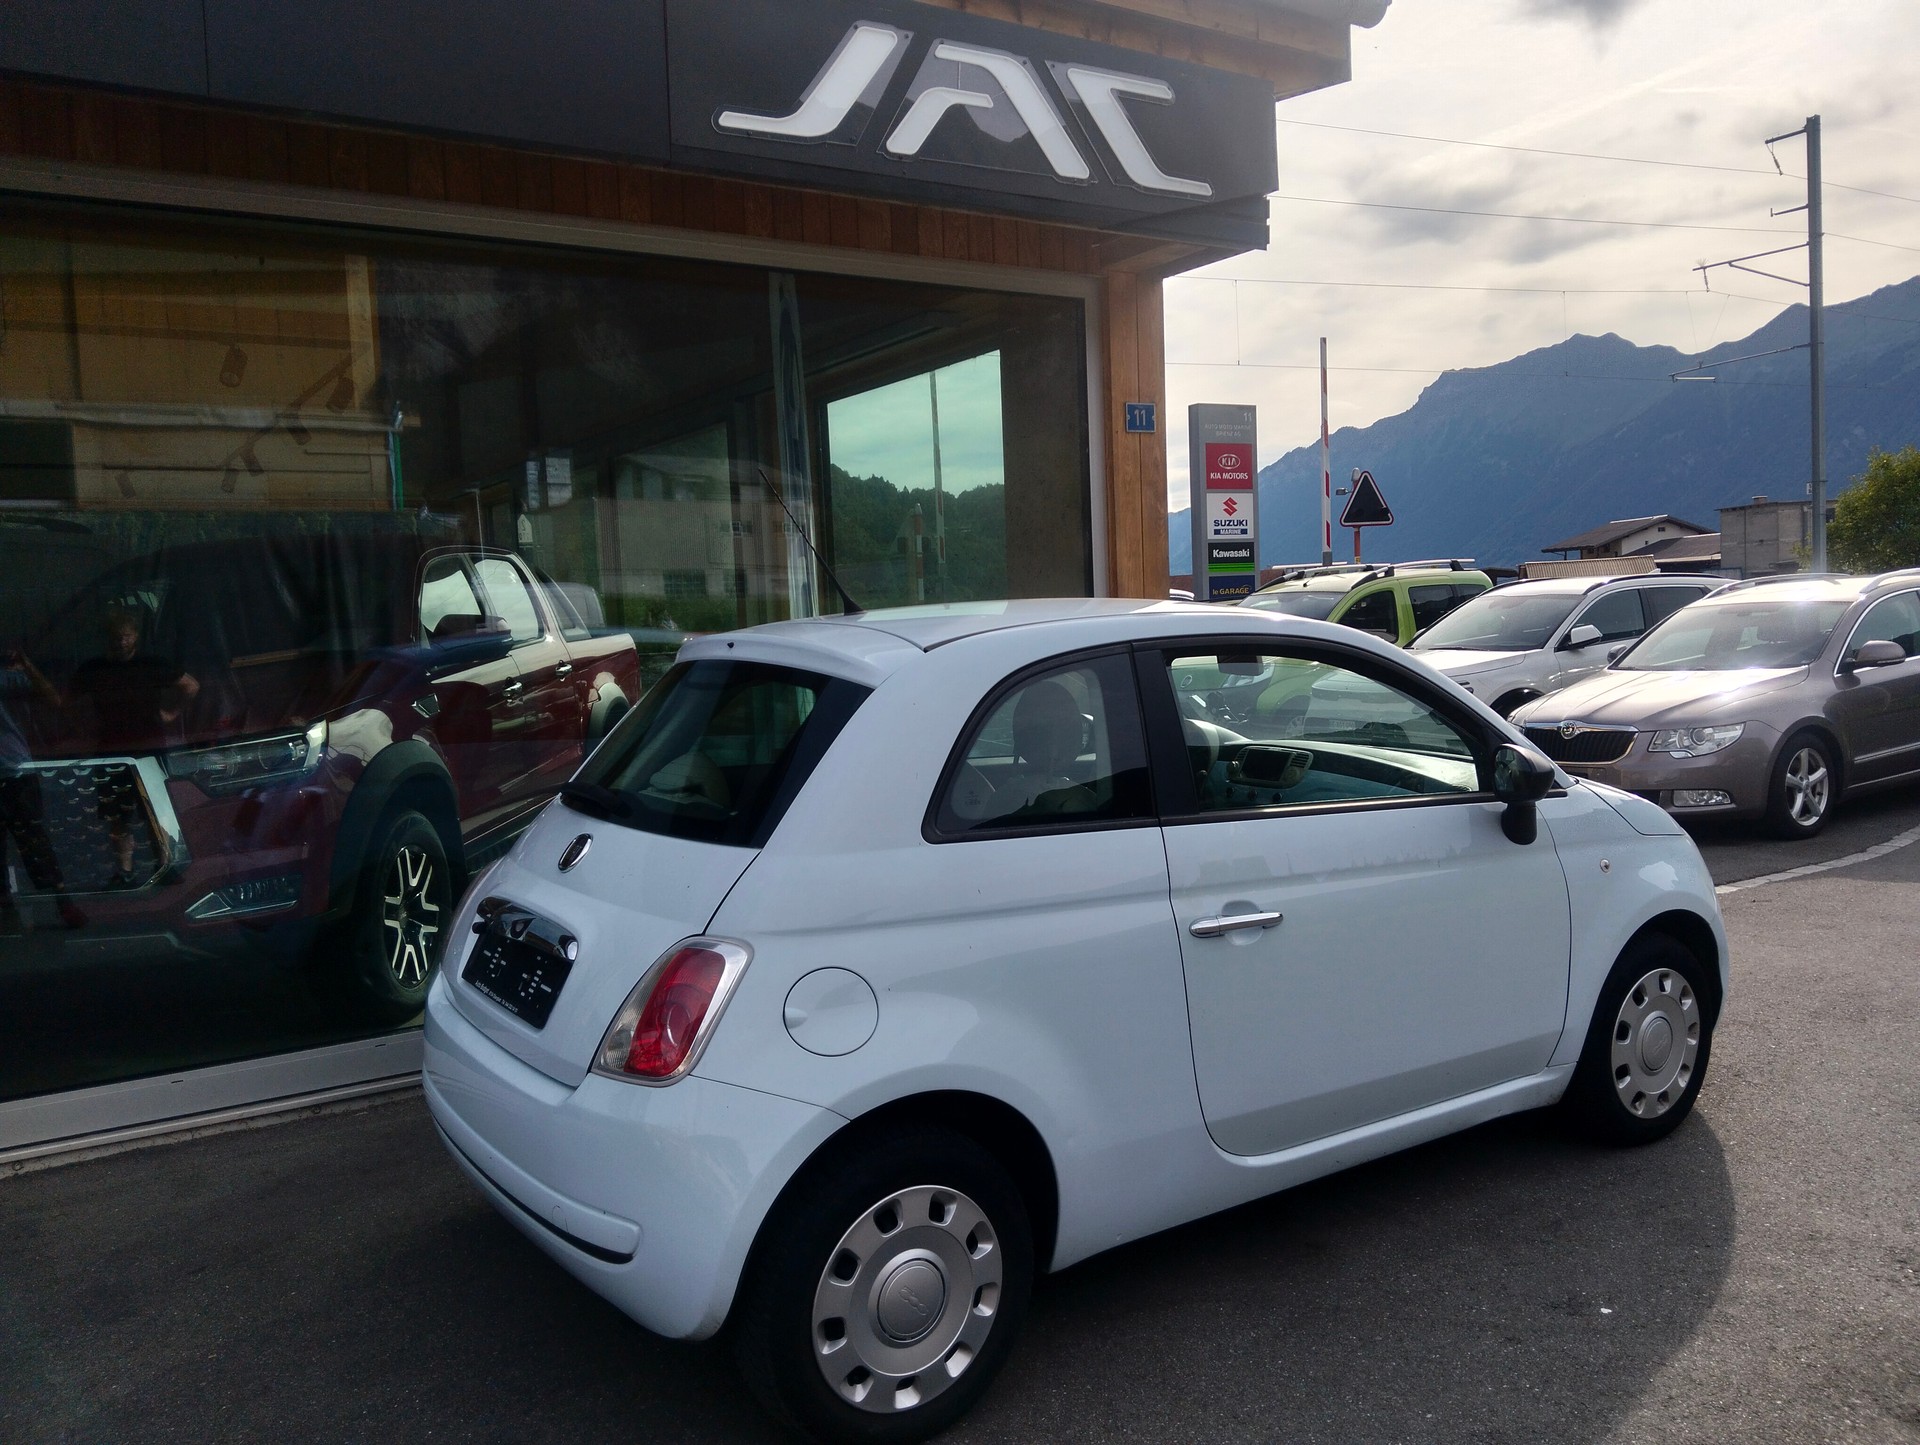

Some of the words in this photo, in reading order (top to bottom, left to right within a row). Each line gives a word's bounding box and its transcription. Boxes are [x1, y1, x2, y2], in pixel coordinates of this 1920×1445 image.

[719, 26, 1212, 196] JAC
[1134, 409, 1146, 426] 11
[1243, 412, 1252, 422] 11
[1221, 457, 1237, 466] KIA
[1210, 472, 1221, 480] KIA
[1222, 472, 1249, 480] MOTORS
[1213, 519, 1248, 527] SUZUKI
[1213, 549, 1250, 558] Kawasaki
[1220, 587, 1250, 595] GARAGE
